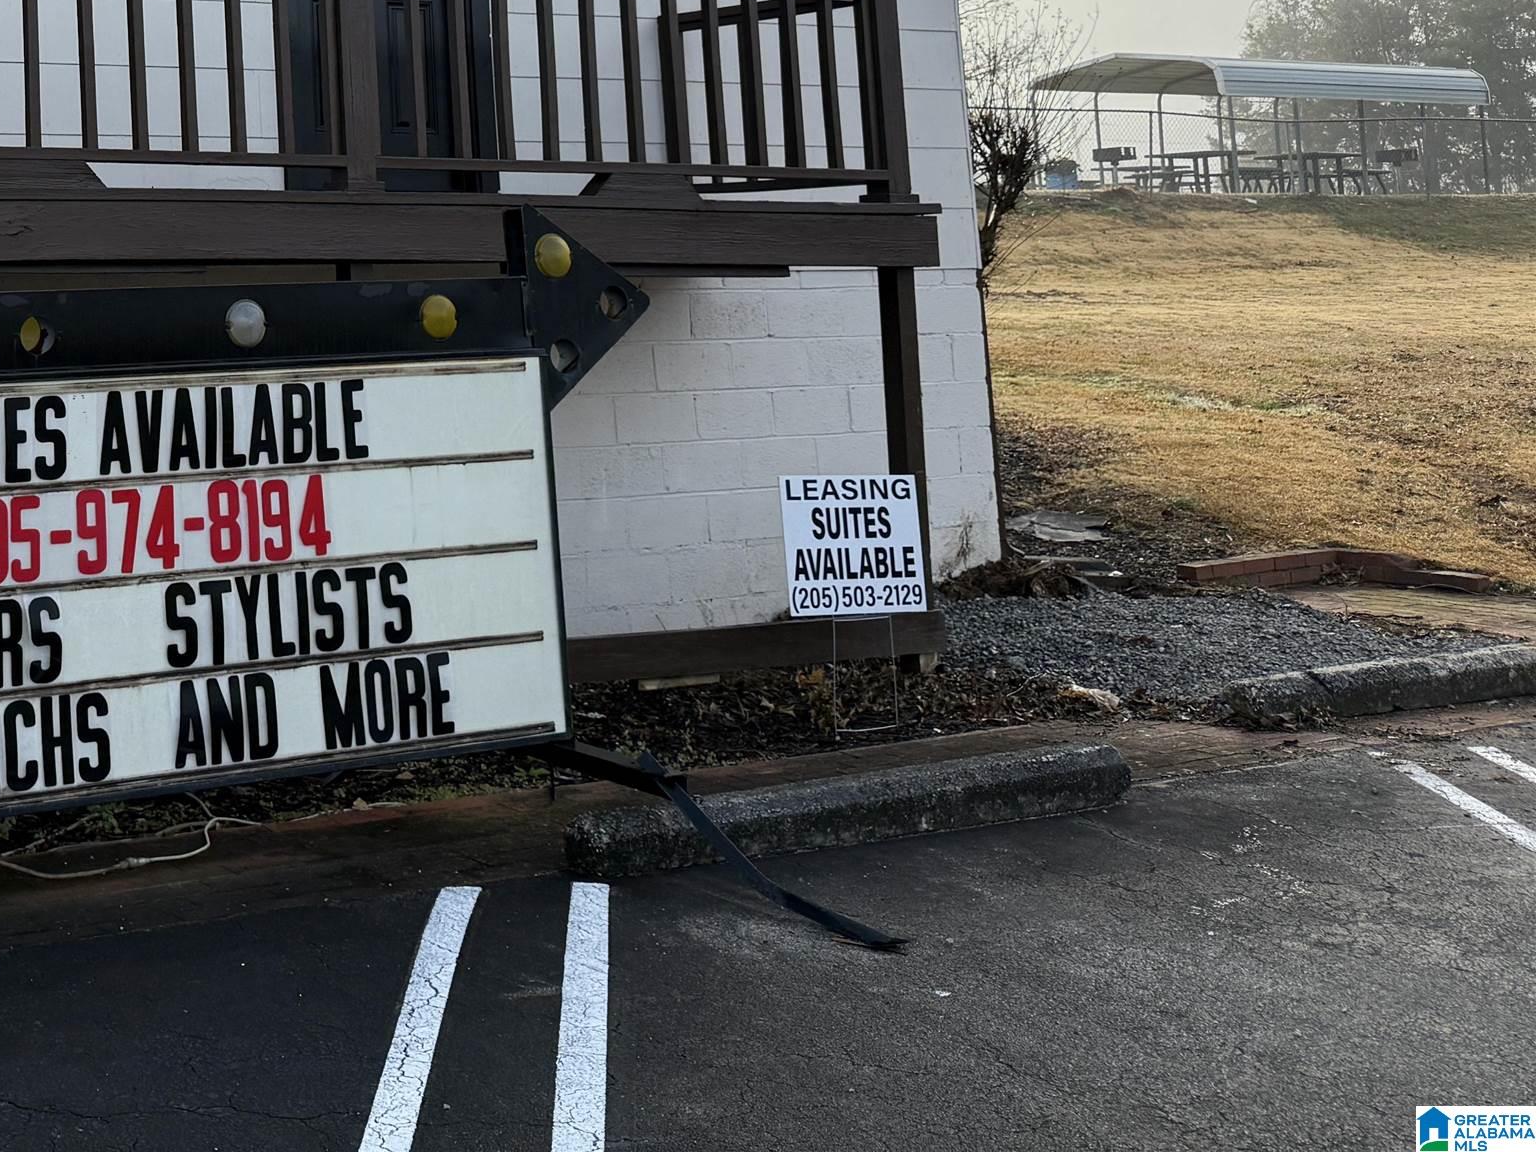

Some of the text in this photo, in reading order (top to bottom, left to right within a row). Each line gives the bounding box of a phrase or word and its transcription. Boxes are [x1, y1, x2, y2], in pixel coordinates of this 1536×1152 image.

[99, 379, 369, 475] AVAILABLE
[785, 479, 911, 500] LEASING
[811, 506, 891, 539] SUITES
[794, 546, 917, 581] AVAILABLE
[165, 562, 412, 668] STYLISTS
[175, 673, 280, 769] AND
[320, 652, 455, 750] MORE
